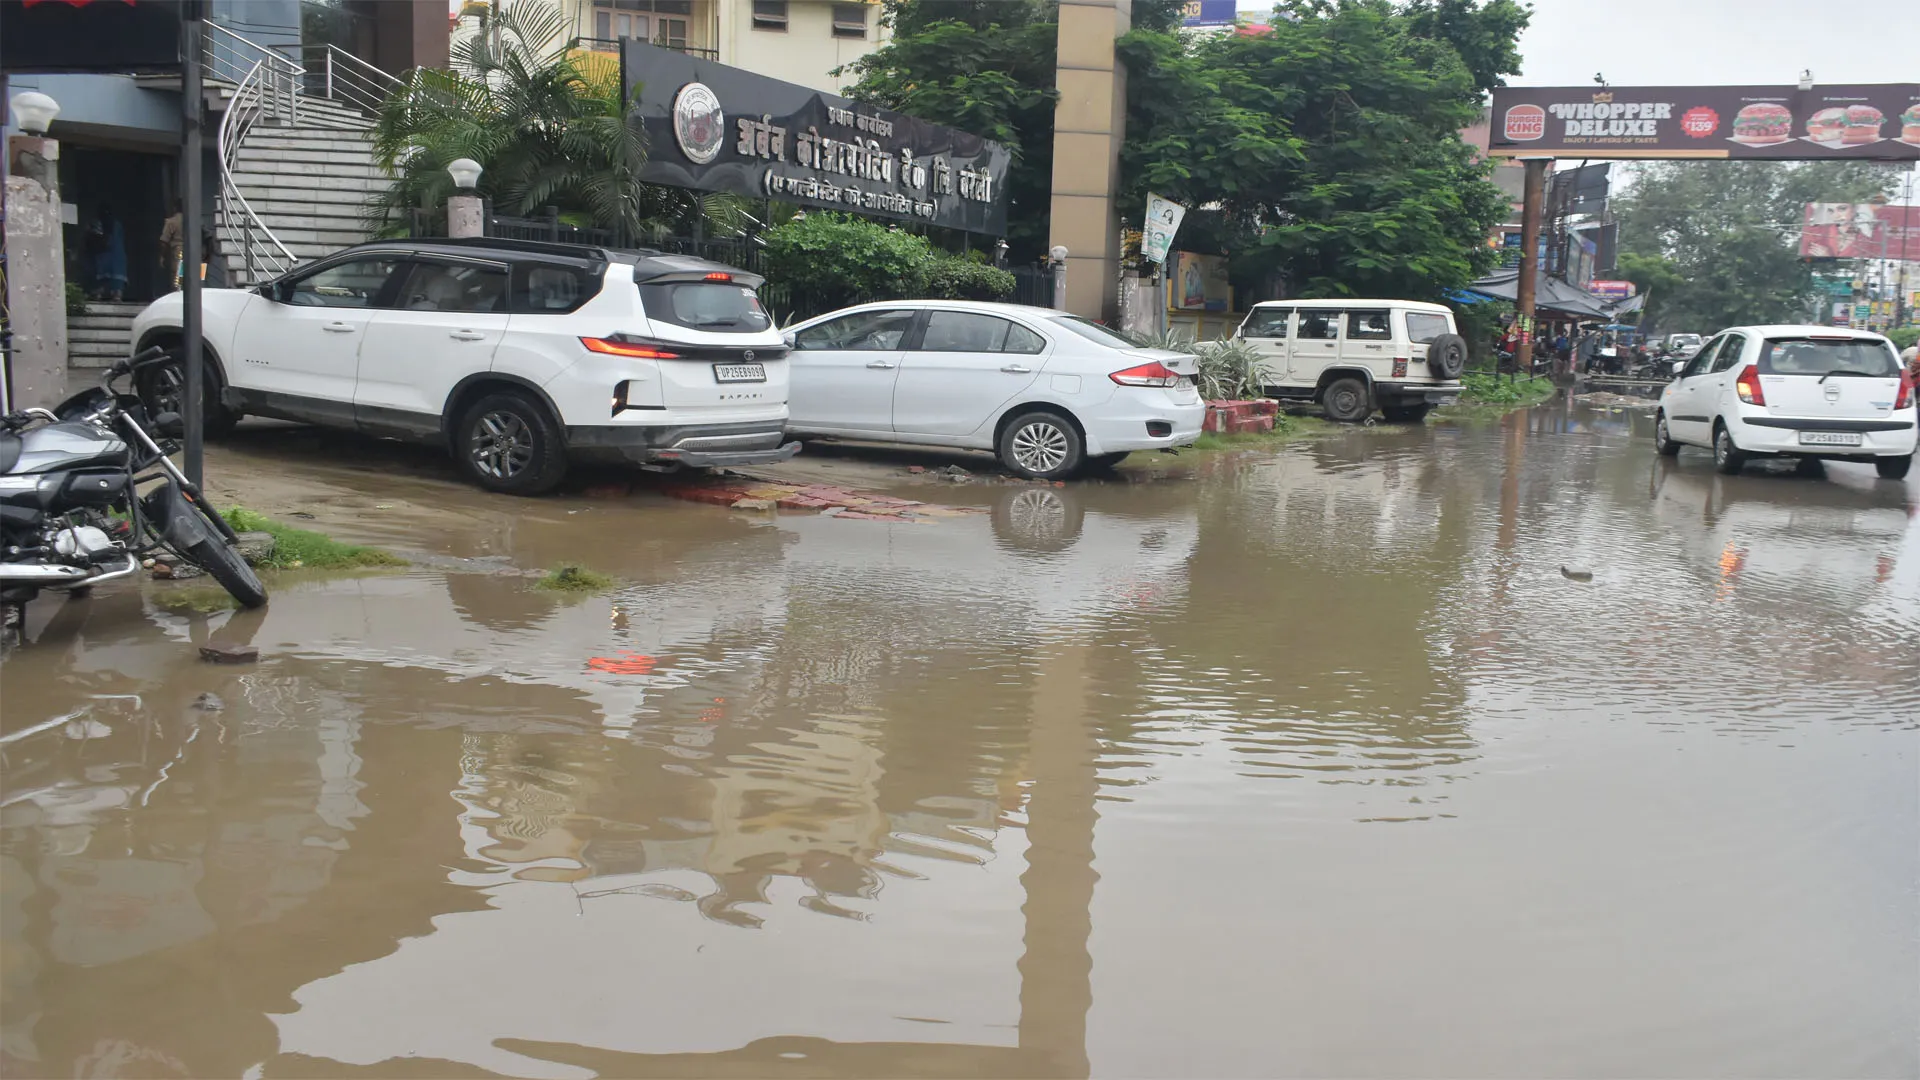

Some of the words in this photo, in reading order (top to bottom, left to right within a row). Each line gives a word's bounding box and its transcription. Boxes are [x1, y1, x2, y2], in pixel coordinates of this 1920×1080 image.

[1548, 102, 1672, 120] WHOPPER
[1507, 115, 1543, 123] BURGER
[1506, 123, 1543, 132] KING
[1564, 119, 1657, 136] DELUXE
